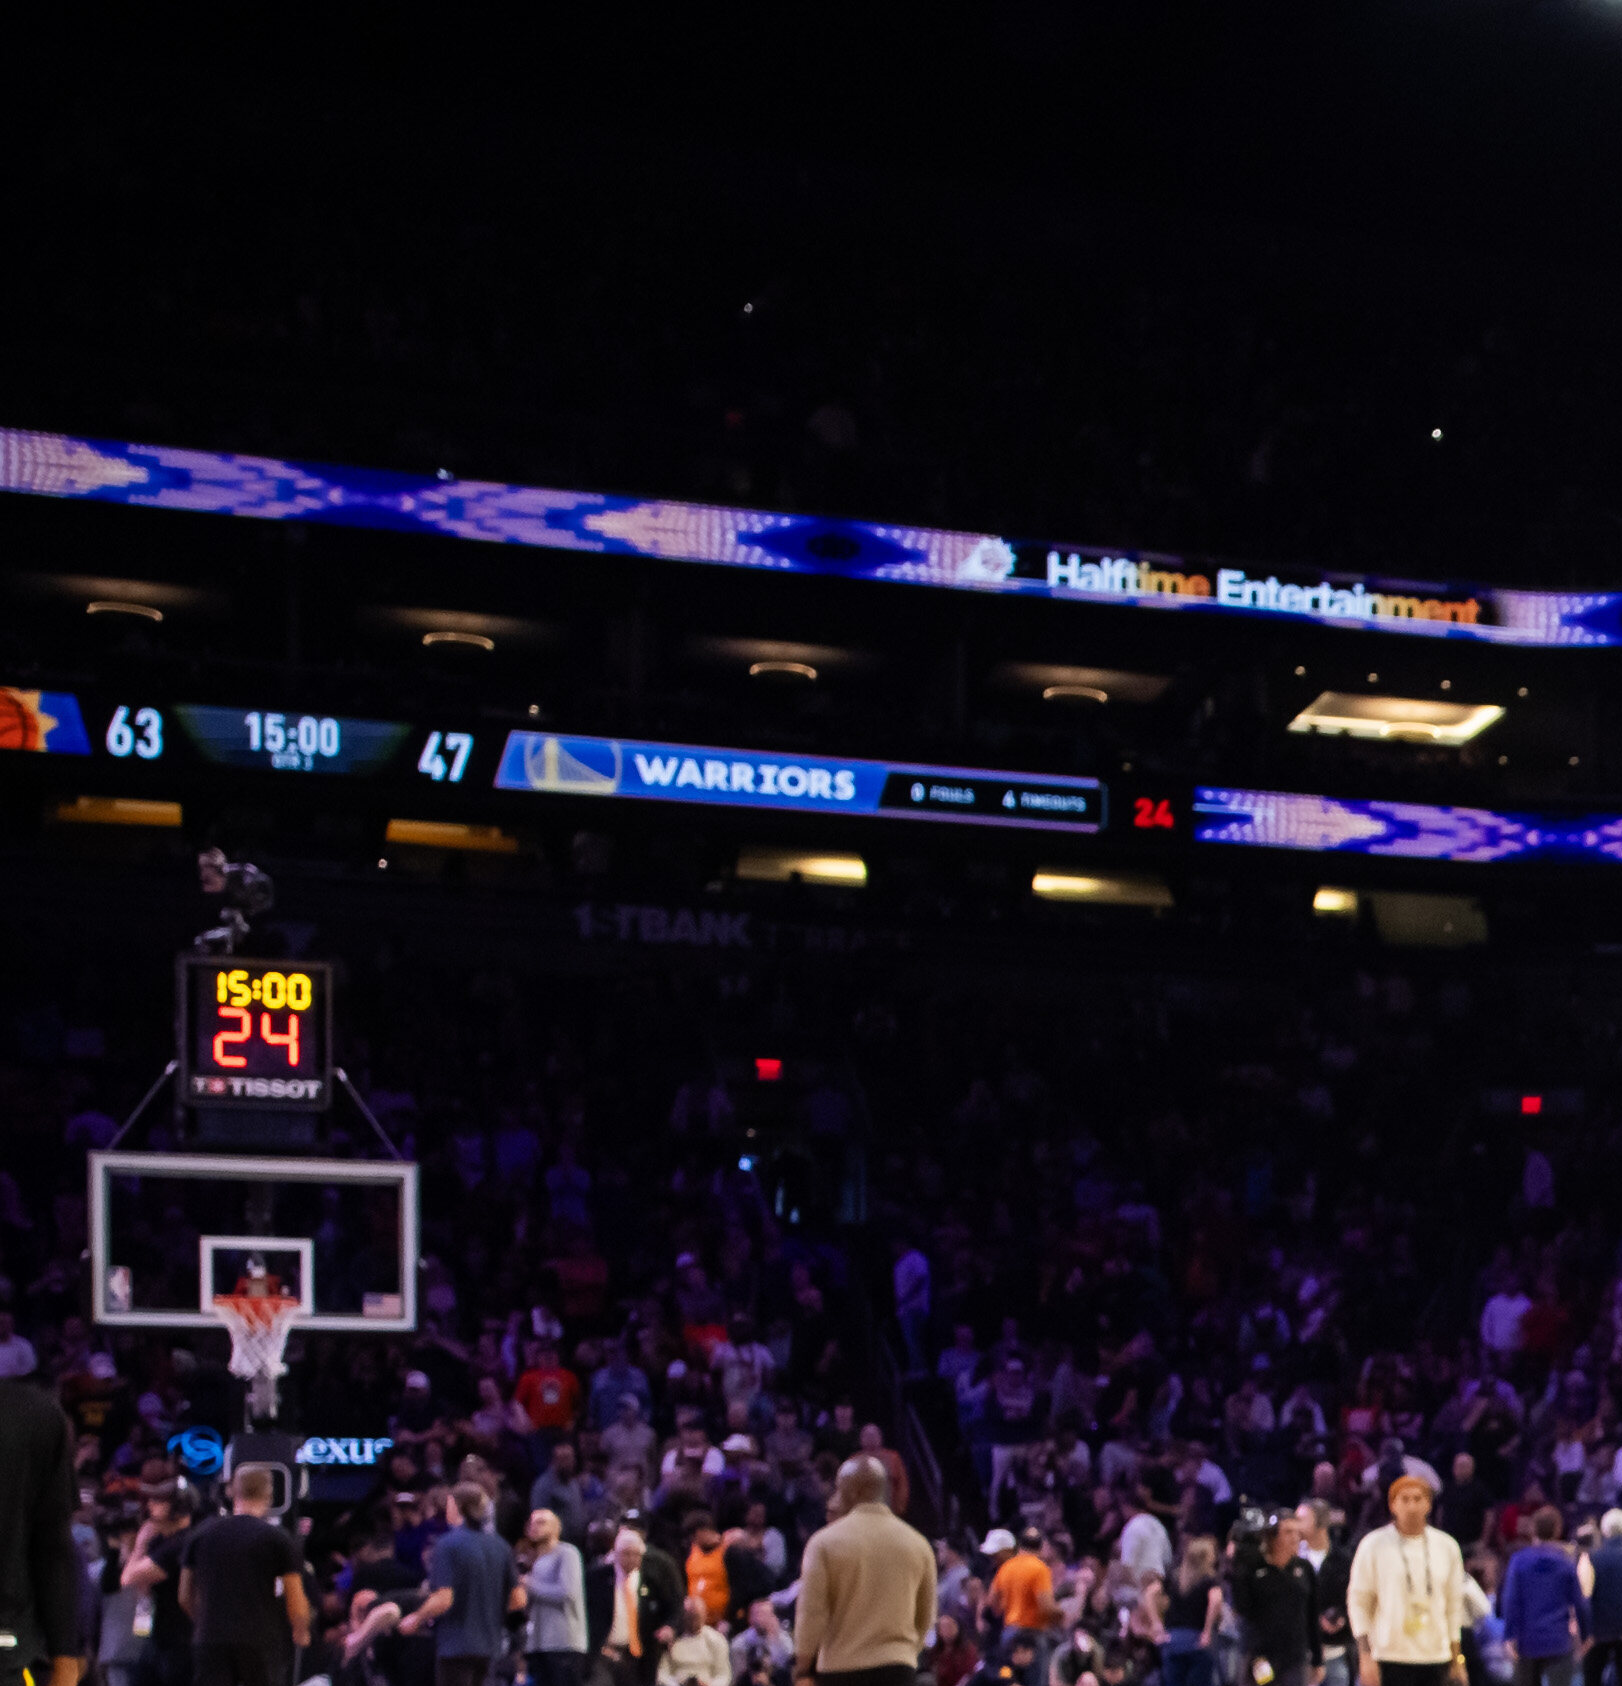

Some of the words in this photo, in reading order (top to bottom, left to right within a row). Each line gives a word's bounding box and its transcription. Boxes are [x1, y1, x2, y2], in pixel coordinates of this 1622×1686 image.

[1046, 551, 1211, 597] Halftime
[1216, 568, 1480, 625] Entertainment
[105, 705, 164, 759] 63
[244, 711, 341, 758] 15:00
[417, 731, 474, 783] 47
[634, 753, 856, 801] WARRIORS
[1133, 797, 1174, 829] 24
[216, 969, 312, 1011] 15:00
[213, 1006, 300, 1068] 24
[228, 1076, 322, 1099] TISSOT
